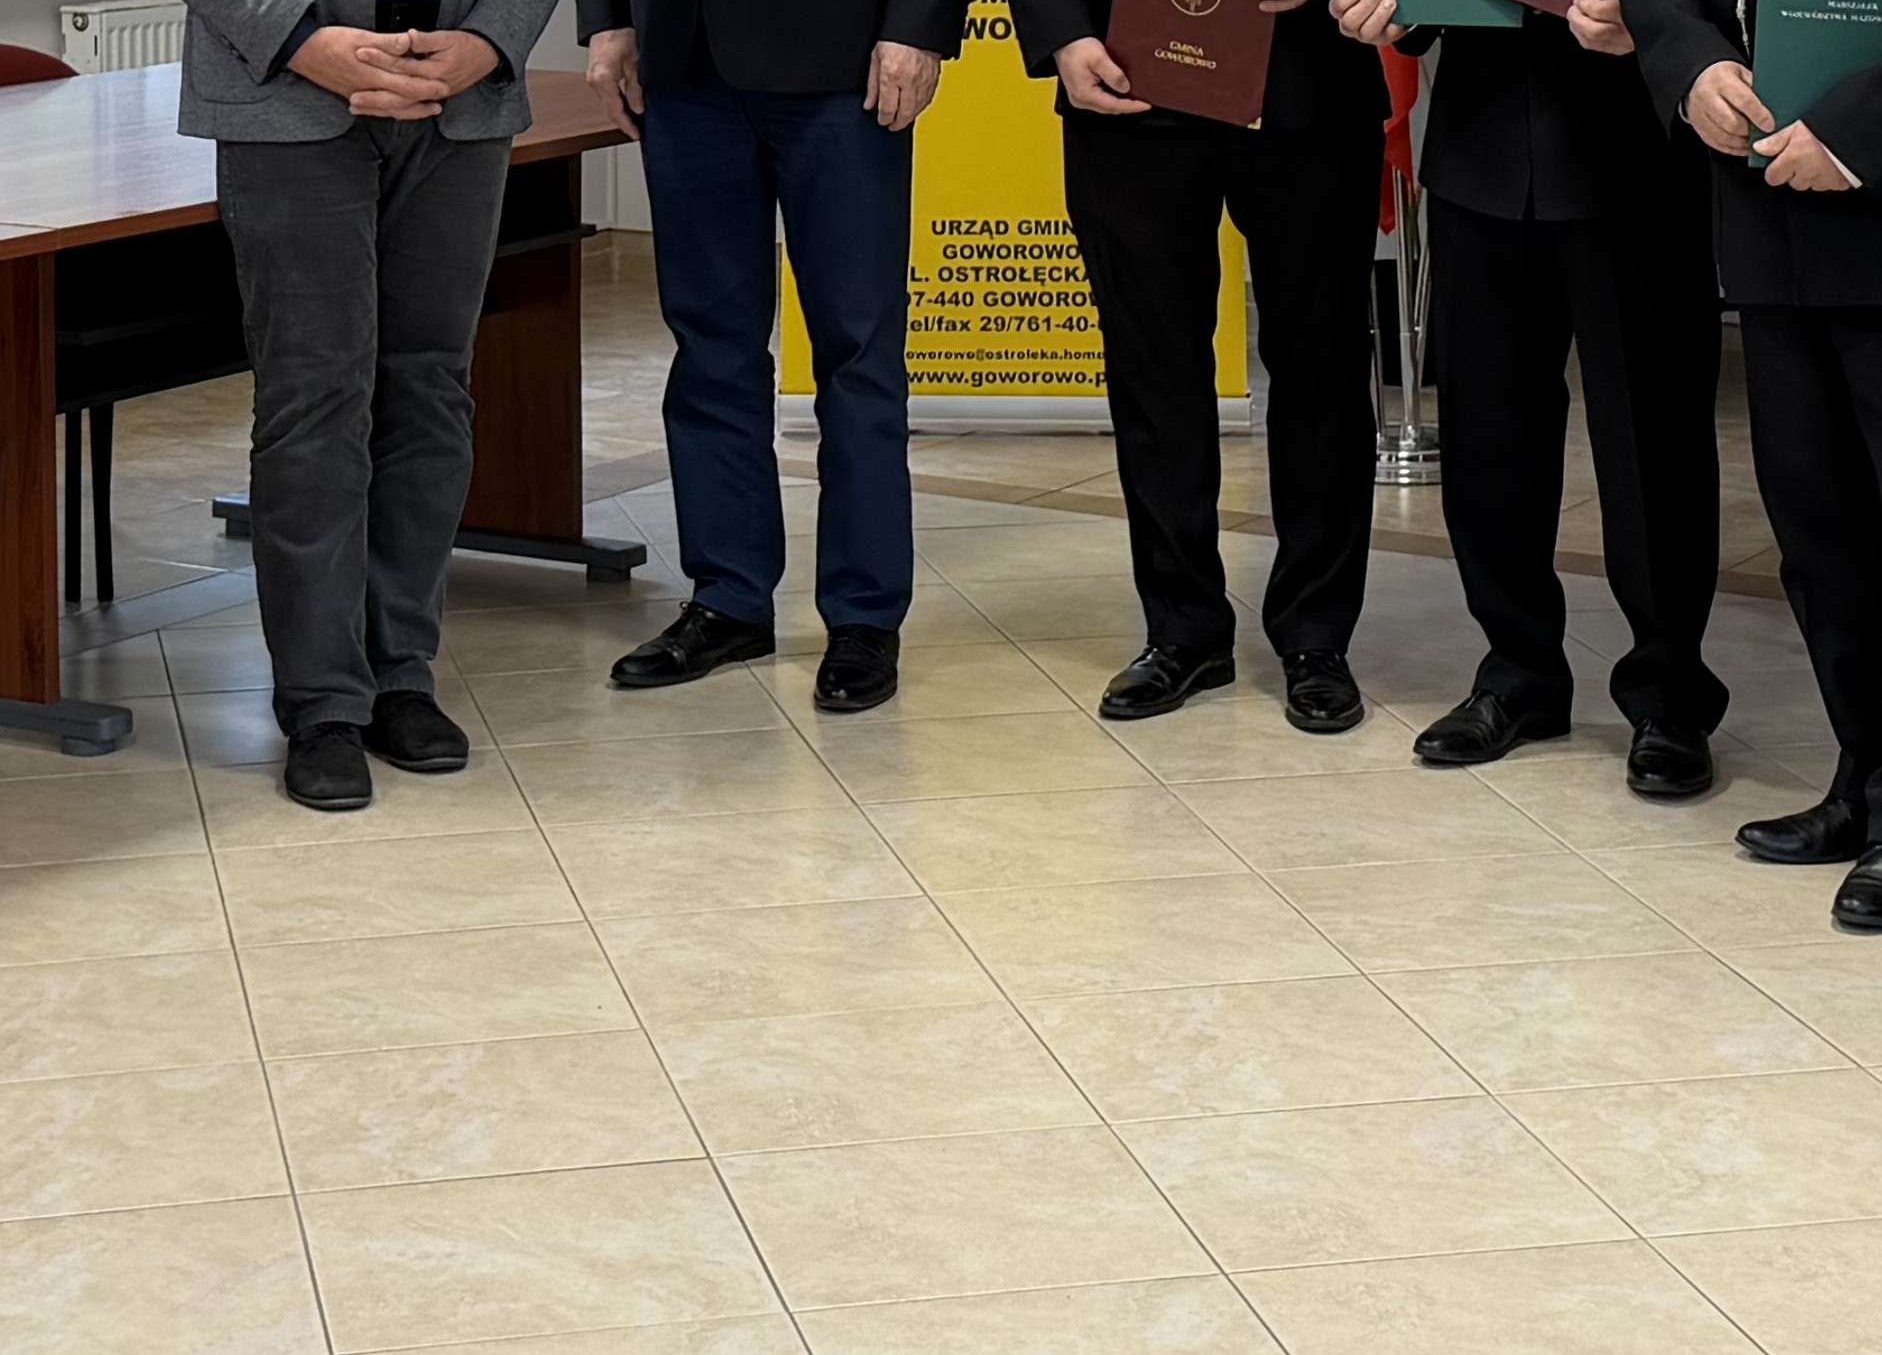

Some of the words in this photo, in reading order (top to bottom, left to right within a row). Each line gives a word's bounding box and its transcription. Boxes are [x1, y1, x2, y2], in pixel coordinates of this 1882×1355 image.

[931, 219, 1010, 240] URZĄD
[1017, 219, 1077, 236] GMIN
[942, 243, 1082, 260] GOWOROWO
[910, 266, 930, 283] L.
[983, 290, 1096, 308] GOWORO
[907, 315, 972, 333] el/fax
[979, 315, 1101, 333] 29/761-40-
[908, 370, 1107, 388] www.goworowo.p
